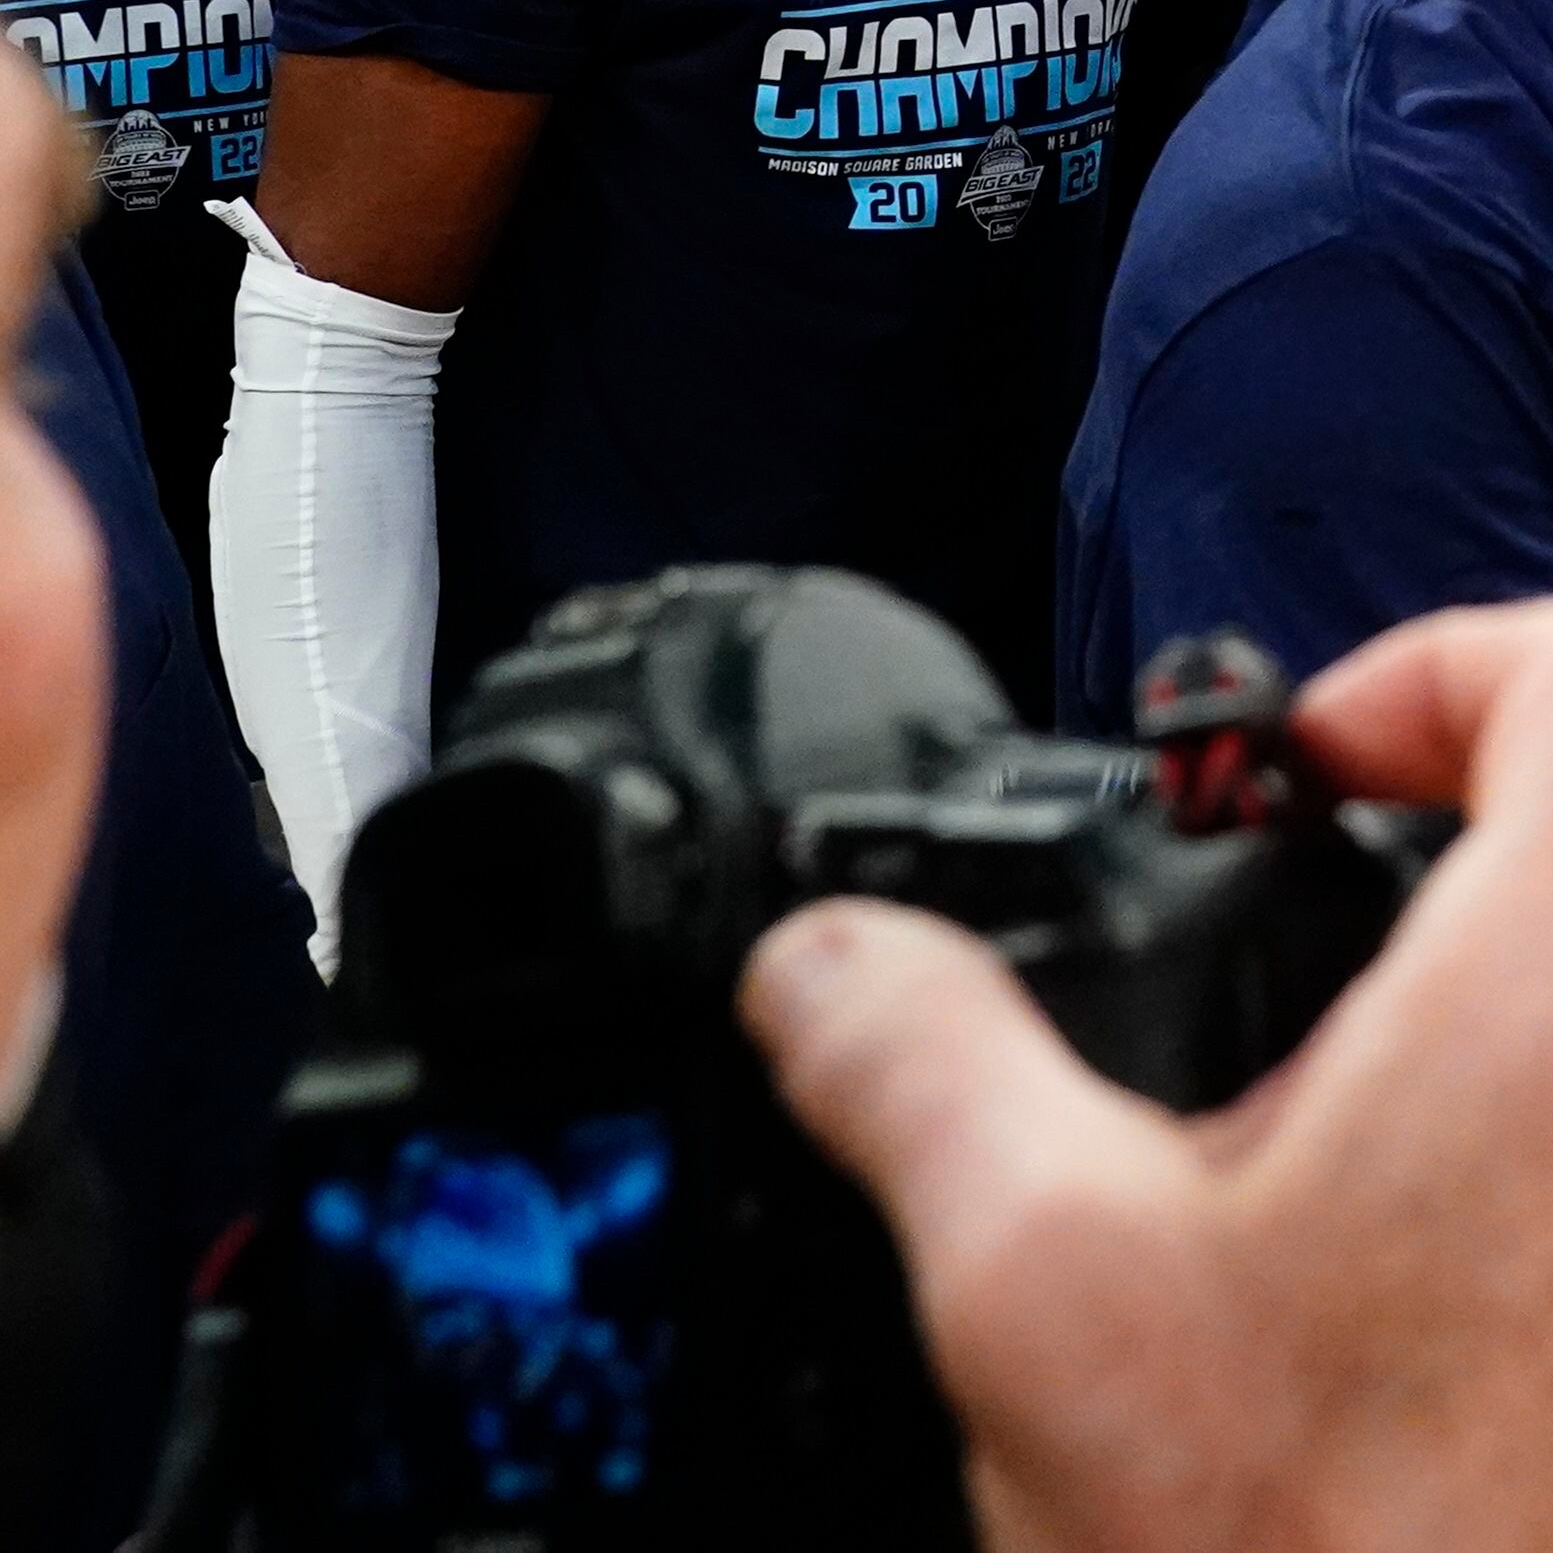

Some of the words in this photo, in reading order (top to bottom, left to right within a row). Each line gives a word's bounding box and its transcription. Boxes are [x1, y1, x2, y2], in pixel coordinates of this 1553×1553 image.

[194, 116, 230, 134] NEW
[1047, 130, 1079, 151] NEW
[134, 147, 186, 164] EAST
[220, 134, 259, 176] 22
[768, 158, 840, 177] MADISON
[905, 151, 964, 171] GARDEN
[965, 179, 994, 193] BIG
[994, 168, 1042, 188] EAST
[1067, 149, 1097, 198] 22
[868, 181, 928, 223] 20
